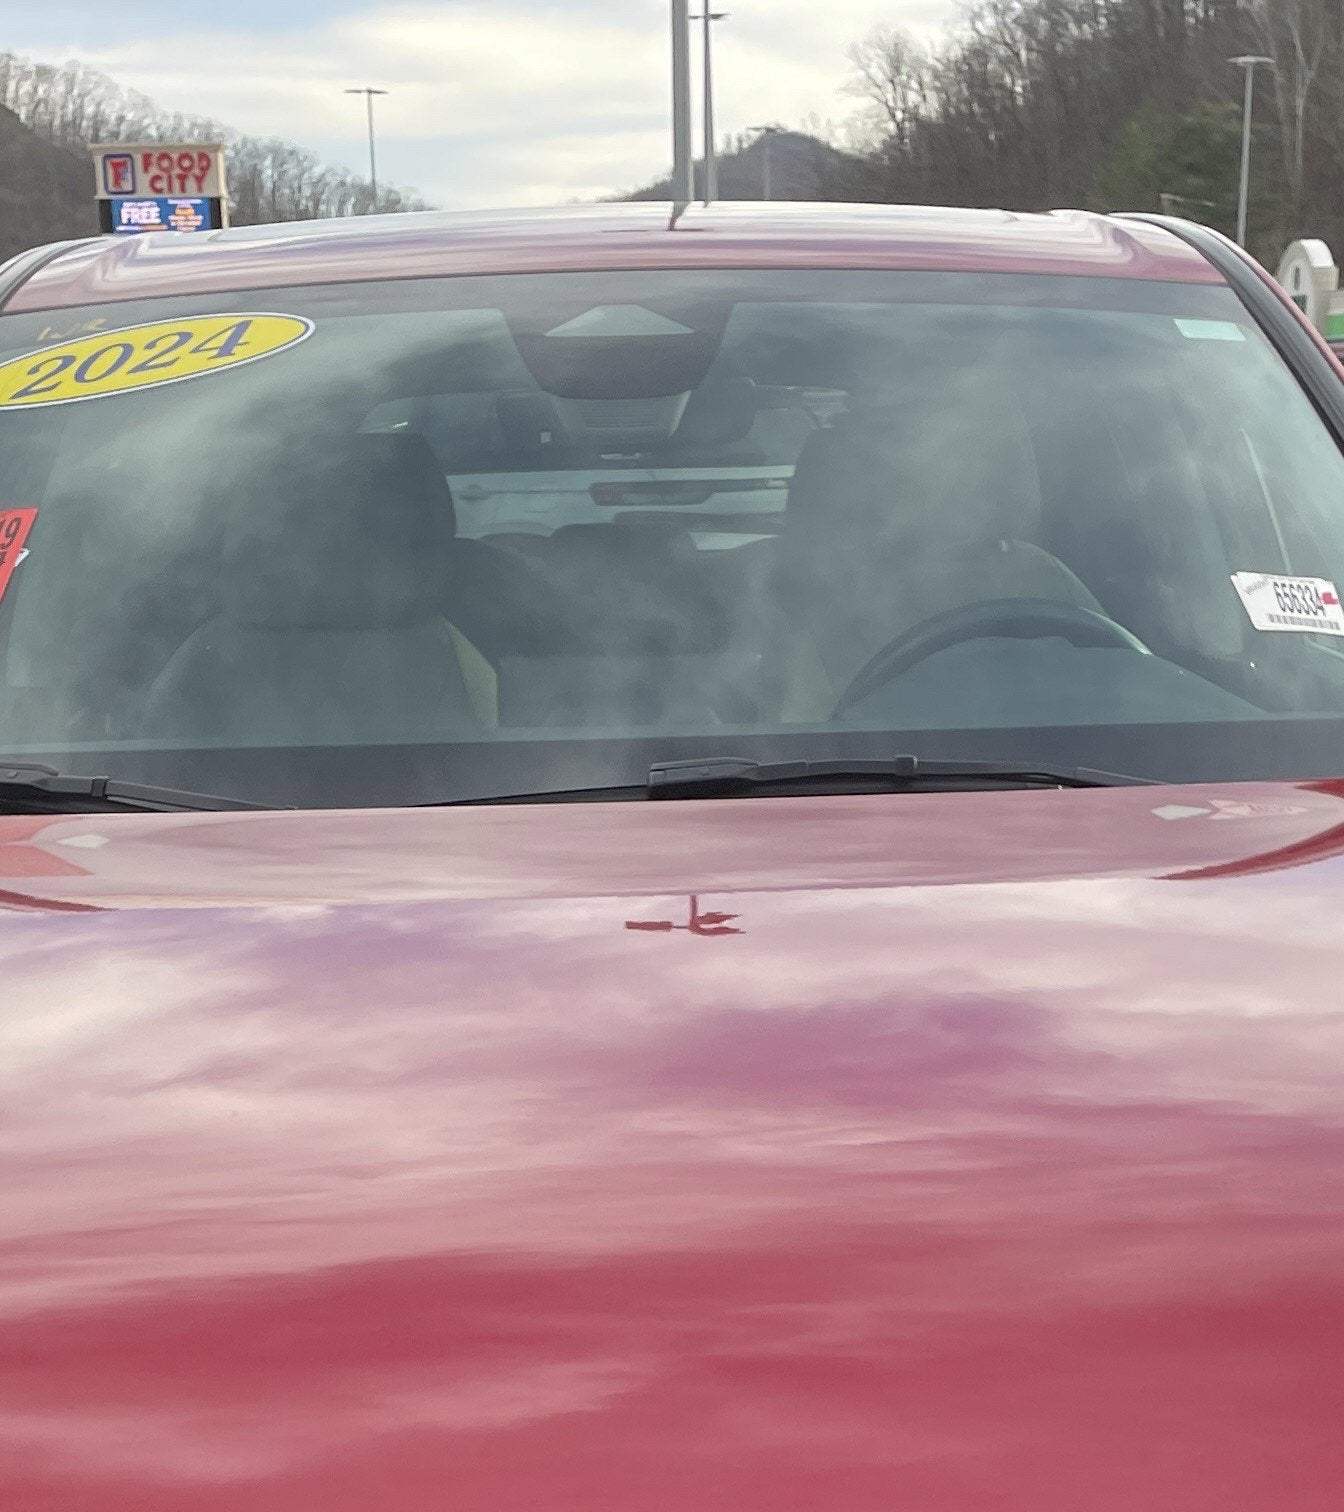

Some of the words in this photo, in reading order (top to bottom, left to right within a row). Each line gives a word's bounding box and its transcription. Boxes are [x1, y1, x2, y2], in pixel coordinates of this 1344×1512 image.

[141, 151, 212, 174] FOOD
[149, 172, 206, 193] CITY
[10, 319, 254, 400] 2024
